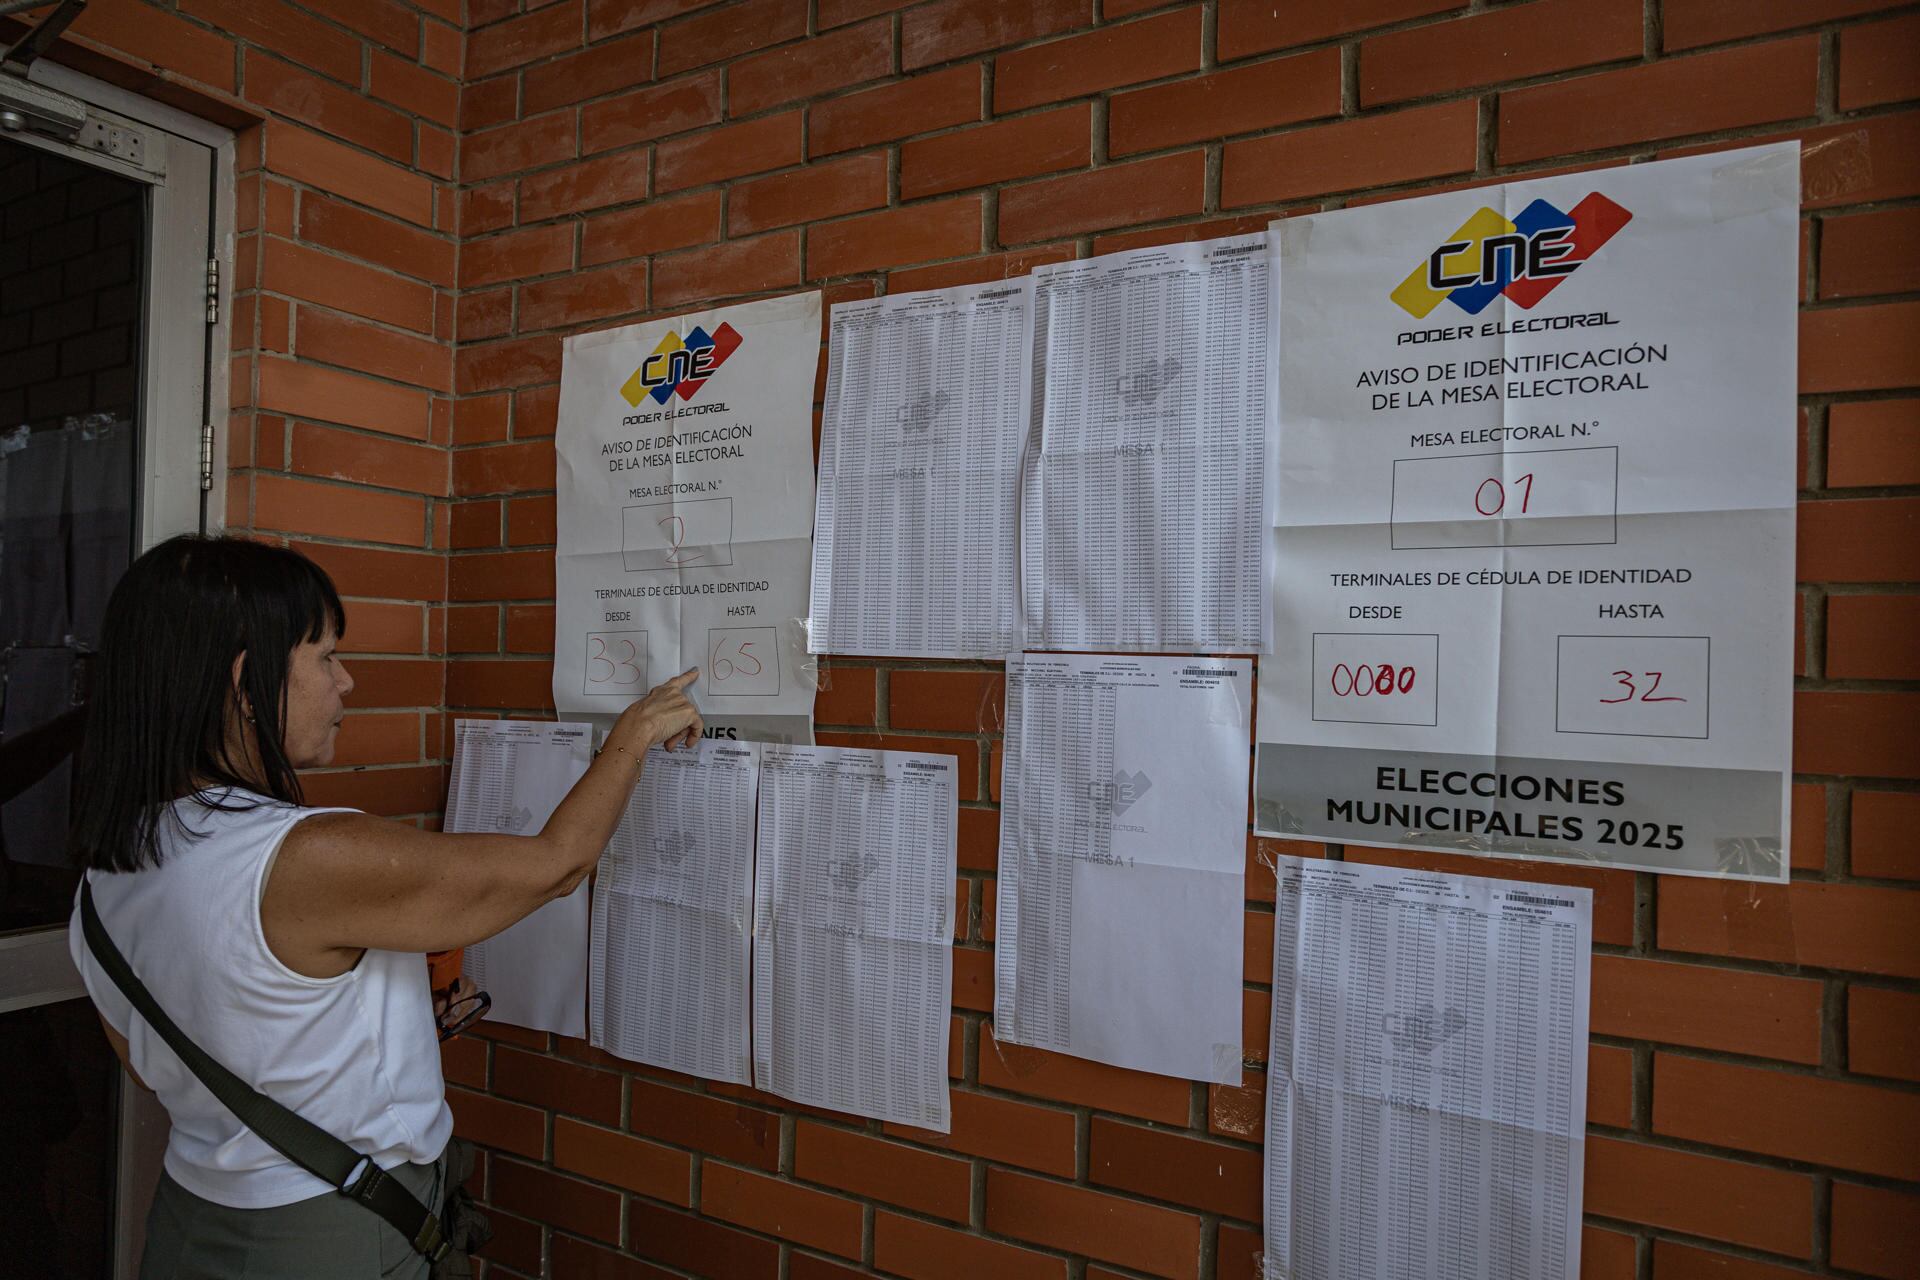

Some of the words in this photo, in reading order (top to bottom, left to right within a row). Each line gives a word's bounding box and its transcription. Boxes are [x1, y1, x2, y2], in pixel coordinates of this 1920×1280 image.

[1430, 225, 1584, 289] CNE
[1398, 325, 1474, 346] PODER
[1480, 312, 1621, 336] ELECTORAL
[641, 346, 716, 386] CNE
[1356, 366, 1420, 388] AVISO
[1427, 362, 1458, 382] DE
[1464, 341, 1669, 379] IDENTIFICACIÓN
[1372, 391, 1401, 411] DE
[1407, 388, 1434, 408] LA
[1441, 384, 1500, 405] MESA
[1507, 372, 1649, 400] ELECTORAL
[622, 412, 662, 426] PODER
[664, 402, 730, 420] ELECTORAL
[601, 439, 633, 456] AVISO
[636, 436, 652, 451] DE
[654, 423, 753, 450] IDENTIFICACIÓN
[1410, 431, 1456, 448] MESA
[1460, 423, 1566, 445] ELECTORAL
[609, 459, 624, 472] DE
[626, 456, 641, 470] LA
[643, 452, 672, 468] MESA
[675, 445, 744, 464] ELECTORAL
[629, 487, 652, 499] MESA
[654, 481, 706, 496] ELECTORAL
[1474, 473, 1534, 516] 01
[595, 586, 646, 599] TERMINALES
[648, 585, 662, 597] DE
[663, 582, 700, 597] CÉDULA
[702, 582, 716, 595] DE
[717, 580, 769, 593] IDENTIDAD
[1330, 571, 1432, 588] TERMINALES
[1436, 570, 1462, 586] DE
[1466, 567, 1541, 586] CÉDULA
[1547, 569, 1573, 585] DE
[1578, 567, 1693, 585] IDENTIDAD
[605, 611, 631, 622] DESDE
[727, 605, 756, 617] HASTA
[1348, 605, 1403, 620] DESDE
[1599, 603, 1665, 620] HASTA
[589, 637, 641, 685] 33
[712, 637, 762, 681] 65
[1600, 670, 1688, 703] 32
[1376, 765, 1626, 807] ELECCIONES
[1326, 797, 1583, 843] MUNICIPALES
[1596, 817, 1685, 851] 2025
[1086, 852, 1123, 867] MESA
[1381, 1093, 1430, 1113] MESA
